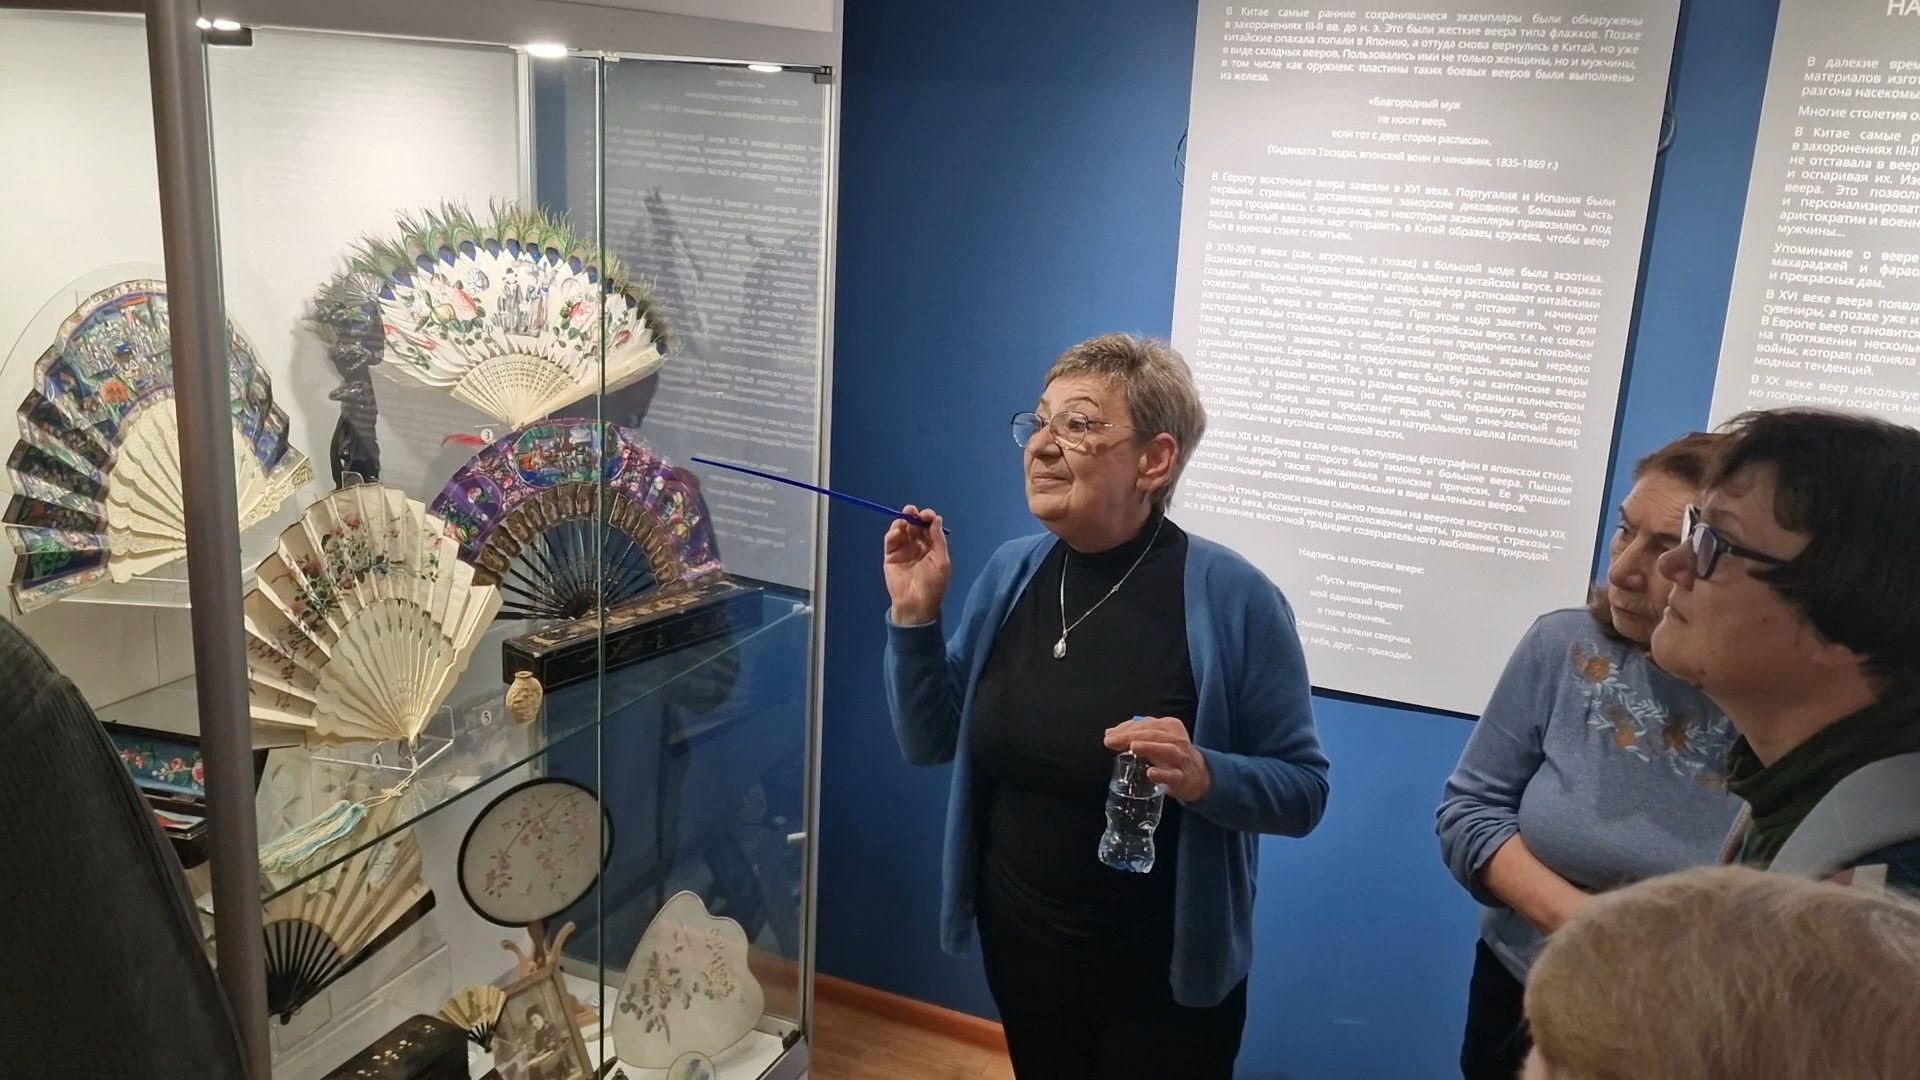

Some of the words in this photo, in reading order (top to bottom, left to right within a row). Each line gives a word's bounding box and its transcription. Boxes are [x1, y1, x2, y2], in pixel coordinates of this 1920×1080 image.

[1226, 6, 1232, 15] В
[1241, 6, 1269, 16] Китае
[1278, 9, 1309, 17] самые
[1318, 10, 1356, 20] ранние
[1365, 11, 1447, 21] сохранившиеся
[1456, 13, 1522, 24] экземпляры
[1532, 13, 1561, 23] были
[1571, 14, 1643, 28] обнаружены
[1233, 21, 1302, 31] захоронениях
[1305, 21, 1323, 30] III-II
[1343, 24, 1356, 33] до
[1384, 23, 1403, 33] Это
[1406, 23, 1434, 34] были
[1437, 26, 1481, 35] жесткие
[1484, 28, 1516, 38] веера
[1521, 29, 1546, 37] типа
[1604, 29, 1641, 40] Позже
[1807, 56, 1815, 66] В
[1824, 58, 1878, 69] далекие
[1804, 73, 1881, 84] материалов
[1801, 87, 1852, 96] разгона
[1798, 105, 1846, 117] Многие
[1849, 110, 1907, 120] столетия
[1794, 126, 1803, 136] В
[1813, 127, 1850, 138] Китае
[1860, 131, 1901, 141] самые
[1792, 142, 1800, 150] в
[1801, 142, 1892, 155] захоронениях
[1789, 156, 1805, 164] не
[1809, 157, 1872, 168] отставала
[1876, 160, 1884, 169] в
[1889, 161, 1920, 173] веер
[1801, 170, 1868, 183] оспаривая
[1874, 175, 1892, 184] их.
[1456, 187, 1517, 200] Португалия
[1522, 193, 1529, 201] и
[1534, 192, 1581, 204] Испания
[1586, 195, 1615, 206] были
[1784, 184, 1823, 195] веера.
[1835, 184, 1858, 196] Это
[1779, 211, 1866, 225] аристократии
[1869, 217, 1877, 225] и
[1777, 225, 1845, 236] мужчины...
[1773, 242, 1853, 258] Упоминание
[1862, 251, 1871, 259] о
[1434, 260, 1481, 273] большой
[1487, 266, 1515, 277] моде
[1520, 267, 1548, 278] была
[1771, 258, 1847, 272] махараджей
[1859, 264, 1868, 272] и
[1780, 272, 1855, 285] прекрасных
[1856, 278, 1884, 288] дам.
[1766, 289, 1774, 299] В
[1778, 290, 1798, 301] XVI
[1802, 294, 1831, 304] веке
[1836, 296, 1873, 309] веера
[1474, 304, 1516, 314] отстают
[1526, 308, 1534, 316] и
[1544, 310, 1598, 322] начинают
[1763, 304, 1825, 318] сувениры,
[1829, 310, 1836, 318] а
[1840, 310, 1879, 321] позже
[1881, 314, 1906, 325] уже
[1910, 316, 1918, 324] и
[1761, 315, 1769, 325] В
[1772, 316, 1816, 329] Европе
[1818, 322, 1848, 334] веер
[1758, 331, 1773, 339] на
[1780, 332, 1856, 347] протяжении
[1756, 343, 1798, 356] войны,
[1802, 348, 1852, 361] которая
[1855, 353, 1916, 365] повлияла
[1753, 357, 1801, 368] модных
[1804, 361, 1873, 376] тенденций.
[1751, 374, 1759, 383] В
[1764, 375, 1780, 385] XX
[1785, 379, 1813, 389] веке
[1819, 382, 1848, 395] веер
[1748, 389, 1763, 397] но
[1844, 399, 1899, 414] остаётся
[1423, 513, 1465, 525] веерное
[1466, 519, 1515, 532] искусство
[1517, 526, 1548, 537] конца
[1549, 529, 1565, 539] XIX
